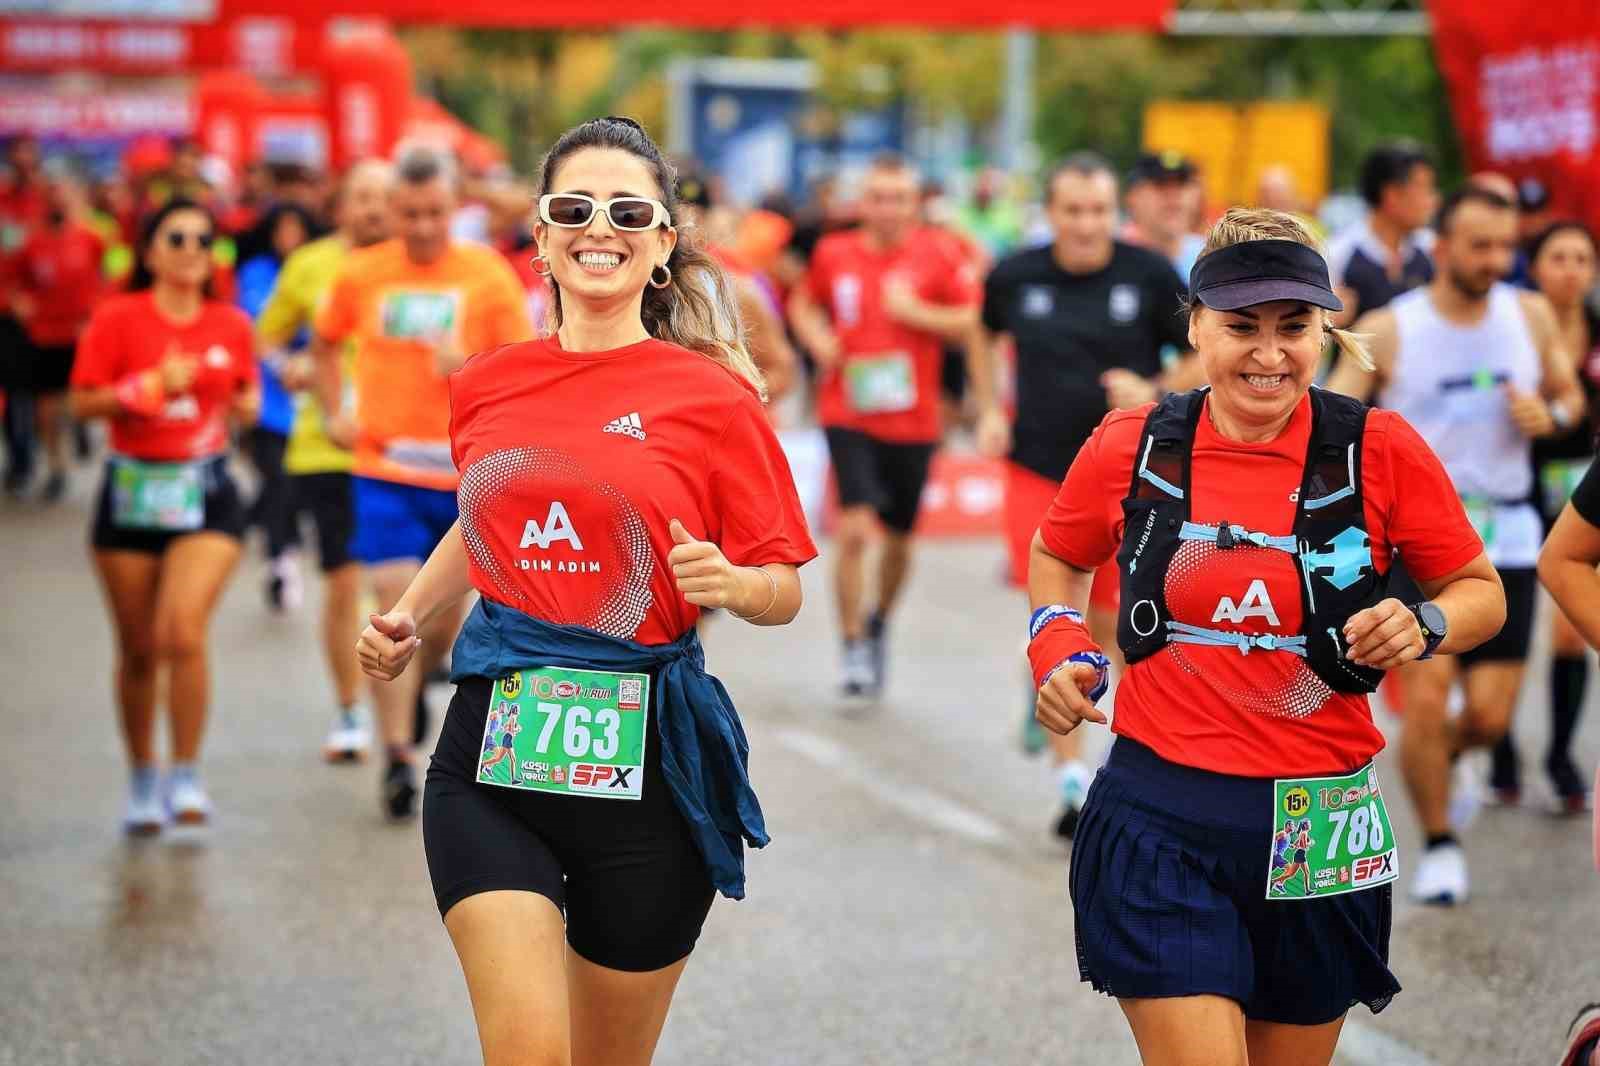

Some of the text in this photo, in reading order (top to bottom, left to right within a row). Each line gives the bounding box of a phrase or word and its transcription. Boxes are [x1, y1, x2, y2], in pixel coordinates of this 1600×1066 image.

[603, 424, 646, 440] adidas
[1135, 508, 1157, 557] RAIDLIGHT
[514, 560, 600, 572] DIM ADIM
[535, 702, 621, 759] 763
[572, 764, 634, 788] SPX
[1327, 800, 1384, 860] 788
[1355, 851, 1392, 880] SPX
